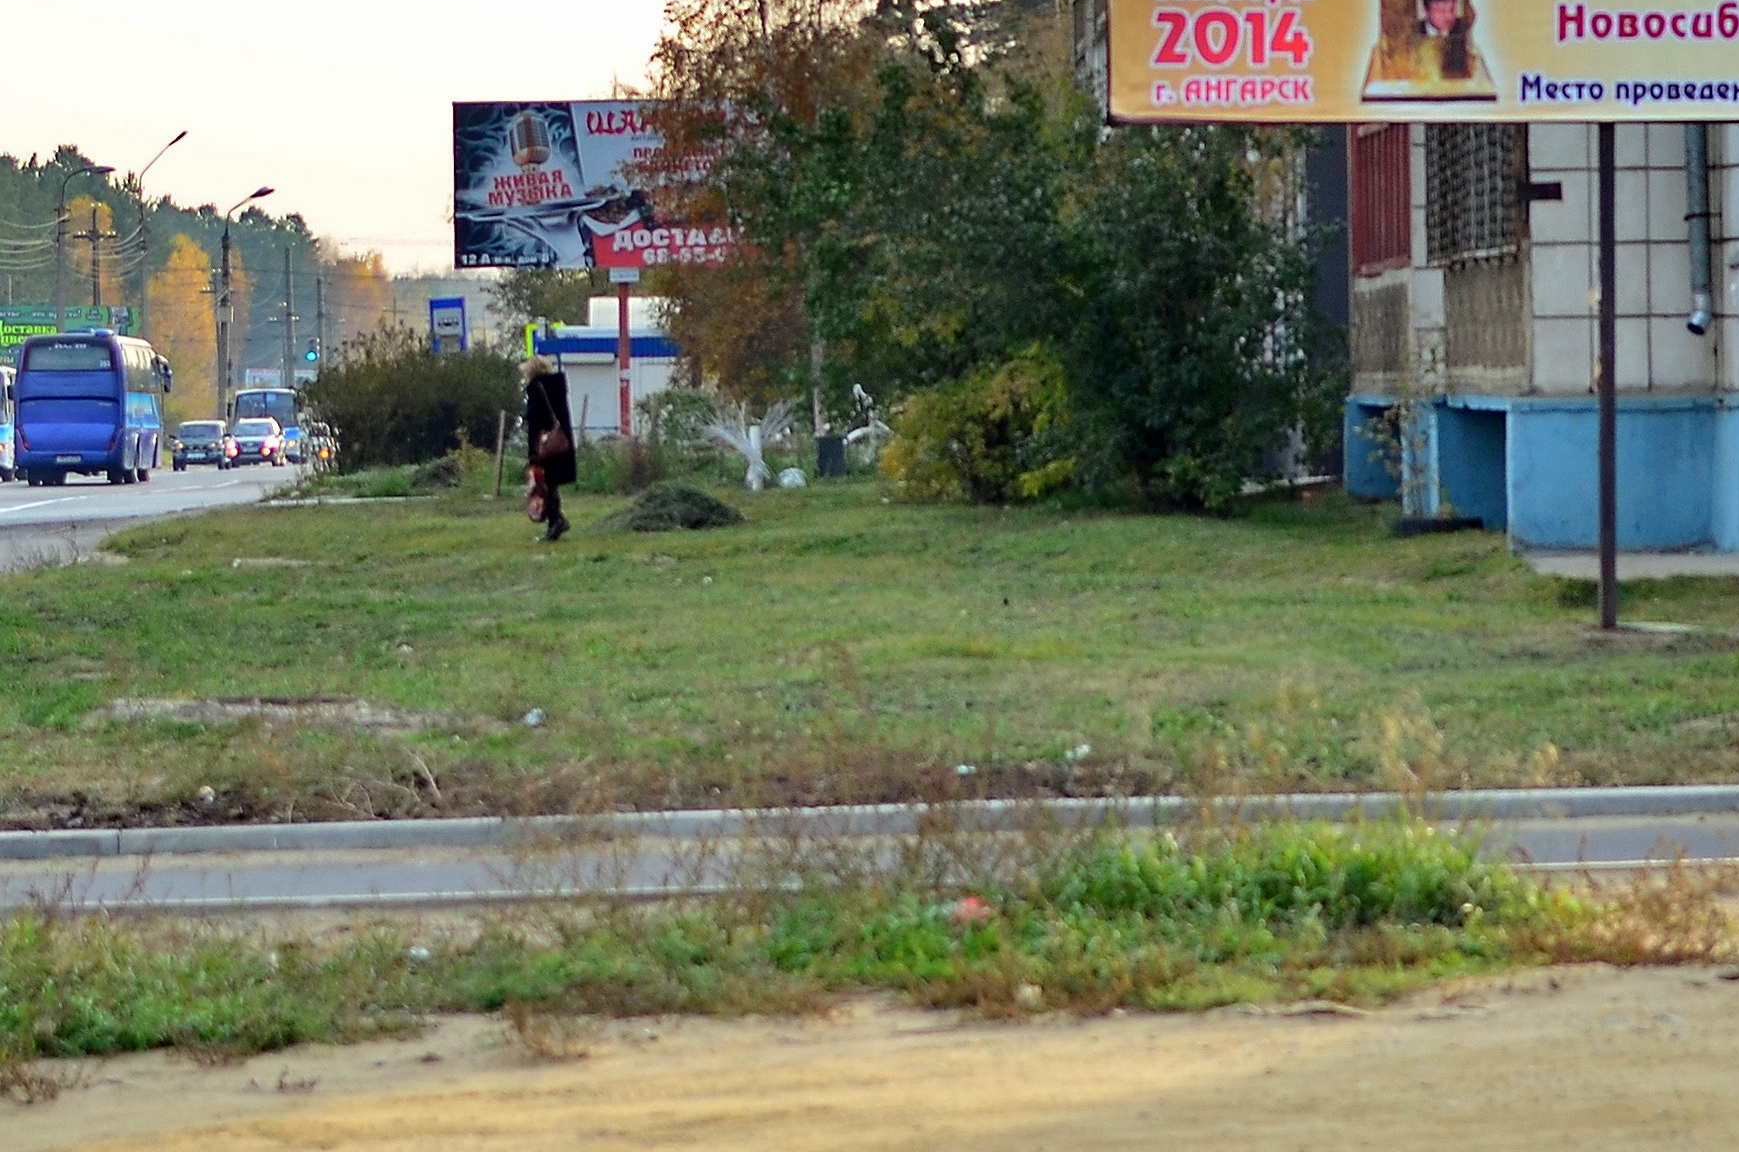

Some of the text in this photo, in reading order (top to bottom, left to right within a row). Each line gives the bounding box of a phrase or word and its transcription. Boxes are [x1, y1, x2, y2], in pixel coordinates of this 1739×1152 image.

[1154, 11, 1309, 64] 2014
[1155, 79, 1312, 102] г. АНГАРСК
[1521, 75, 1604, 101] Место
[493, 169, 564, 189] ЖИВАЯ
[487, 183, 574, 207] МУЗЫКА
